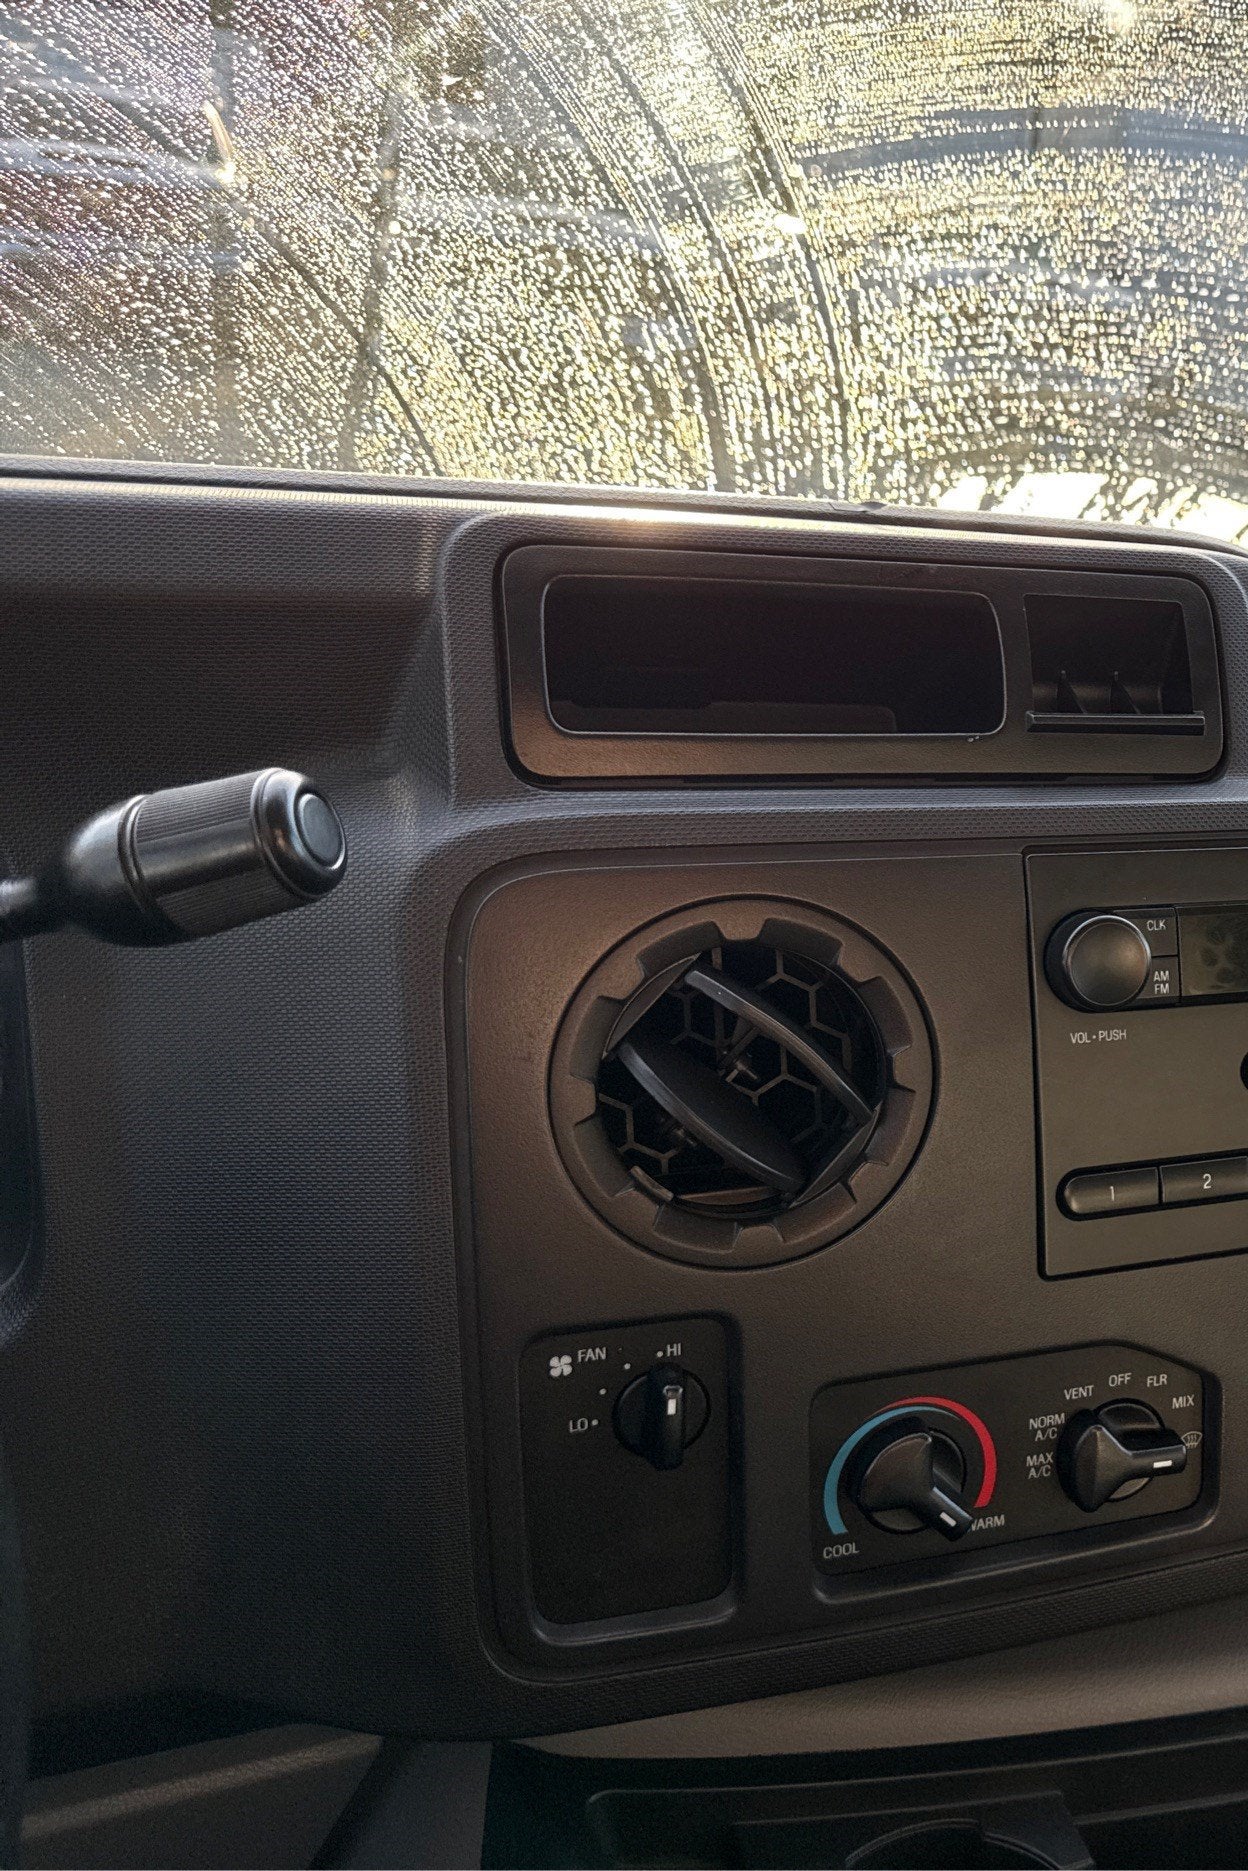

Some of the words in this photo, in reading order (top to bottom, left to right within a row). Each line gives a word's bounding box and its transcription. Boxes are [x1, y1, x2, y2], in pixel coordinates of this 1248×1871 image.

[1146, 920, 1167, 931] CLK
[1153, 970, 1170, 982] AM
[1154, 983, 1170, 995] FM
[1109, 1186, 1115, 1201] 1
[1203, 1174, 1212, 1190] 2
[577, 1347, 607, 1363] FAN
[666, 1343, 682, 1357] HI
[1108, 1373, 1132, 1387] OFF
[1147, 1374, 1168, 1387] FLR
[1064, 1385, 1094, 1400] VENT
[1172, 1395, 1195, 1409] MIX
[569, 1418, 589, 1433] LO
[1029, 1413, 1065, 1430] NORM
[1034, 1427, 1058, 1441] A/C
[1026, 1452, 1054, 1467] MAX
[1028, 1464, 1051, 1479] A/C
[823, 1542, 860, 1559] COOL
